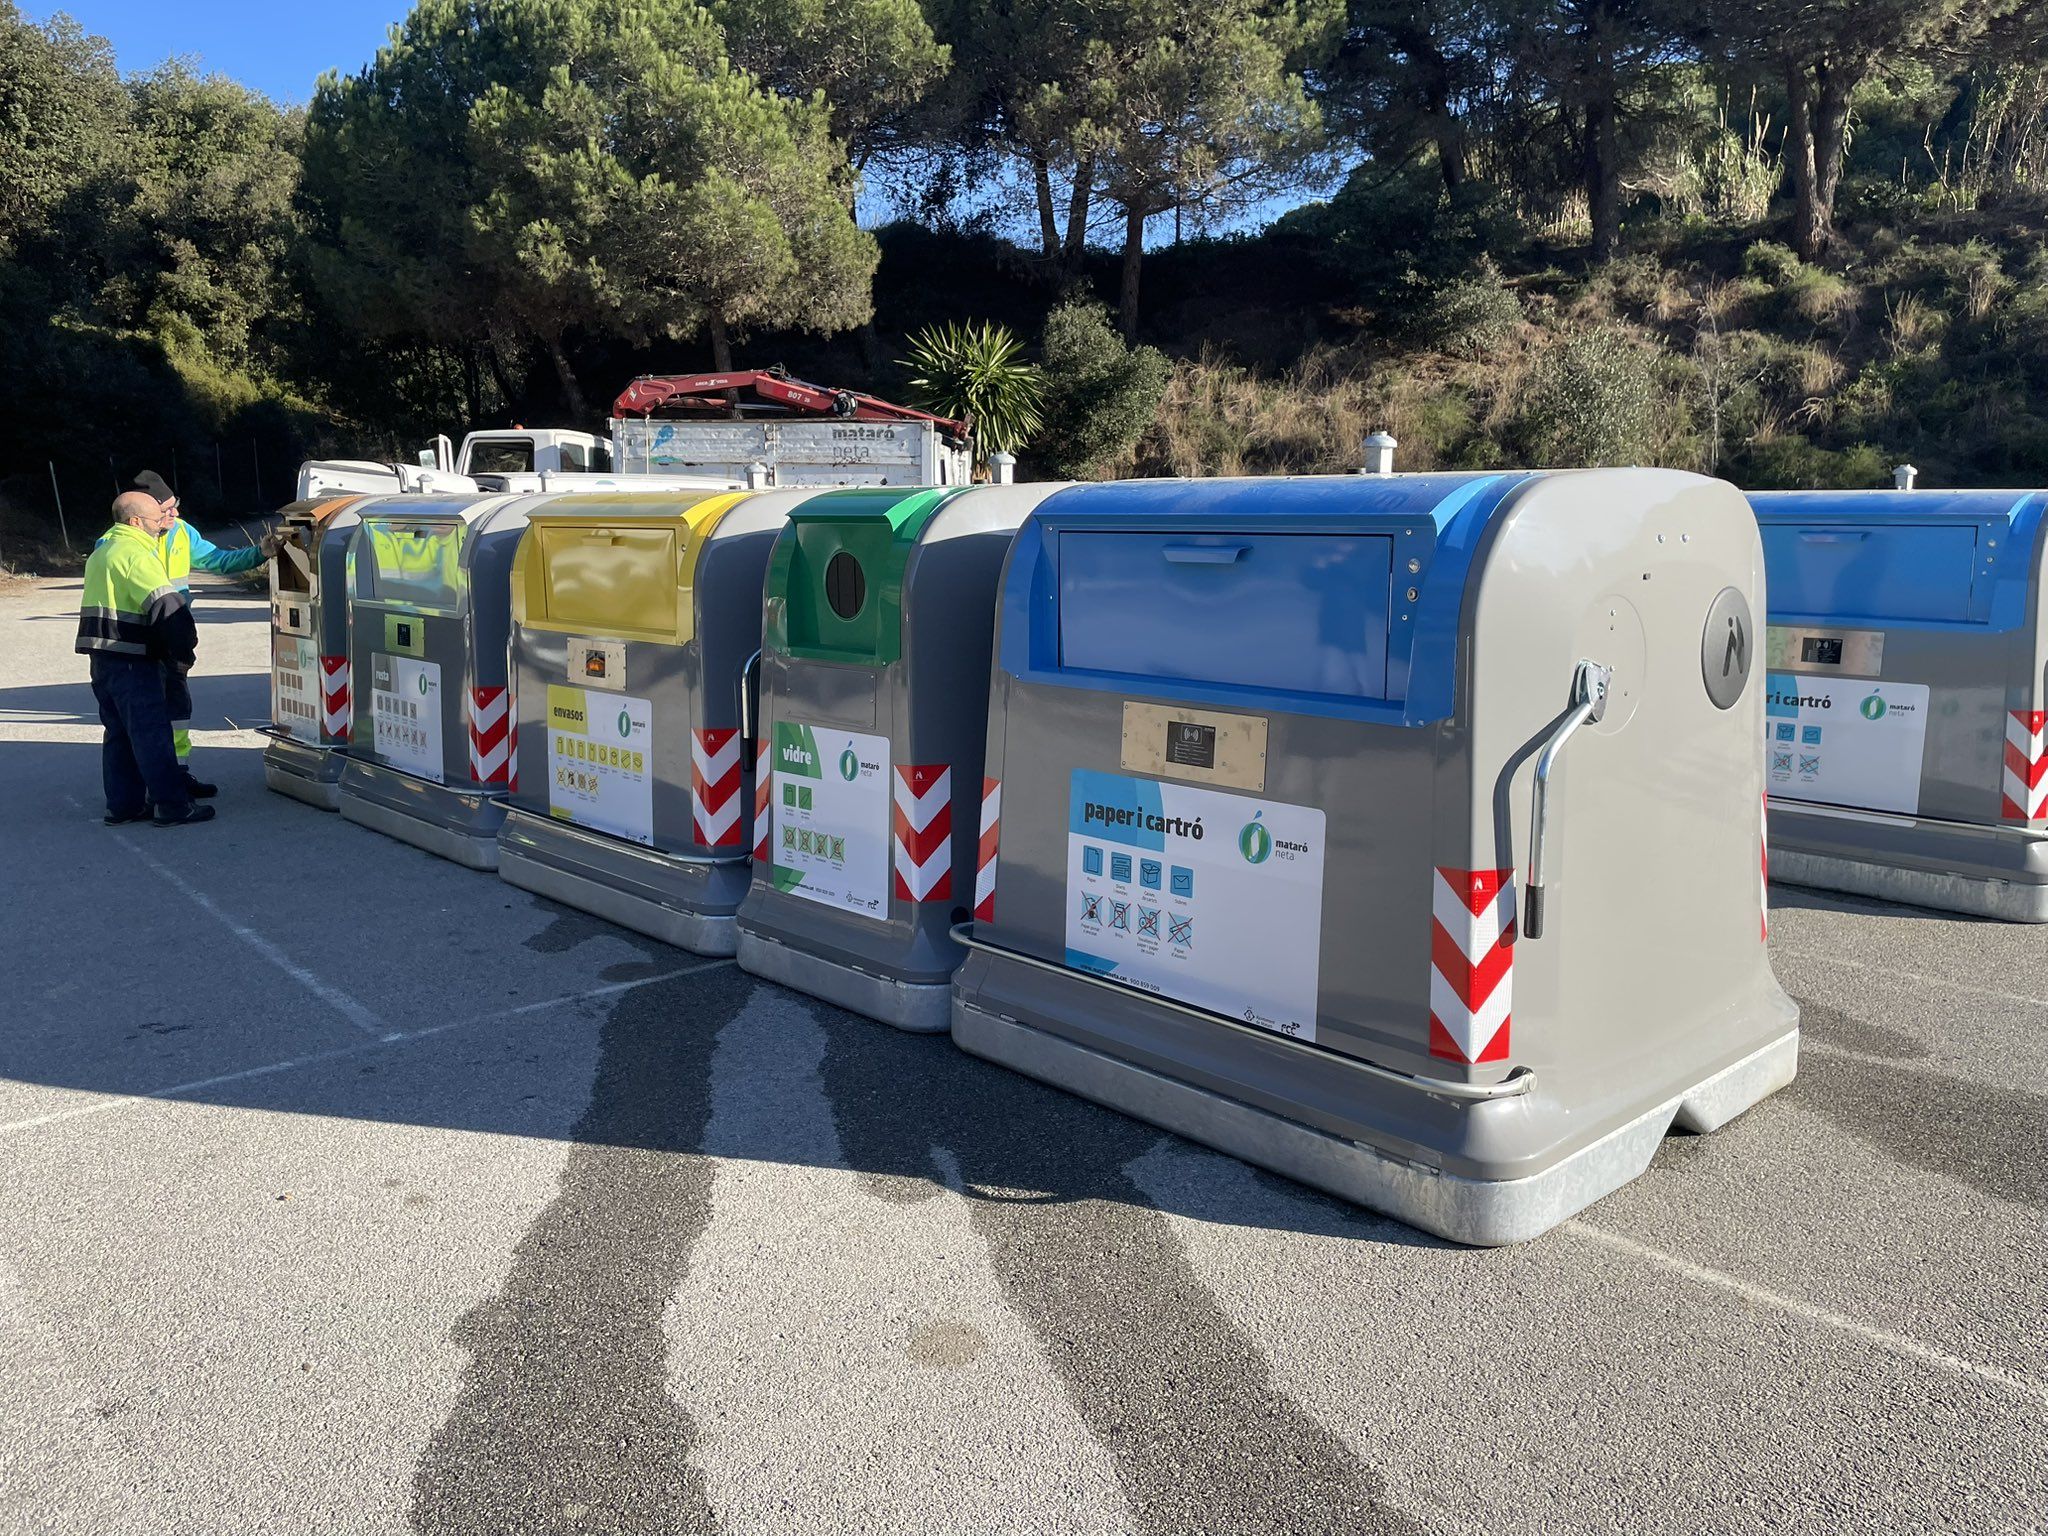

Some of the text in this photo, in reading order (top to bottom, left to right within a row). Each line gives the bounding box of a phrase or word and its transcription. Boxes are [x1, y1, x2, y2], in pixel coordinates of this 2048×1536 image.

[787, 390, 802, 401] 807
[832, 424, 895, 441] mataró
[833, 444, 869, 458] neta
[1775, 691, 1780, 704] i
[1783, 695, 1831, 709] cartró
[1889, 703, 1915, 711] mataró
[553, 706, 584, 722] envasos
[782, 744, 812, 765] vidre
[860, 761, 880, 771] mataró
[1084, 801, 1204, 840] paper i cartró
[1275, 838, 1308, 853] mataró
[1275, 850, 1295, 861] neta
